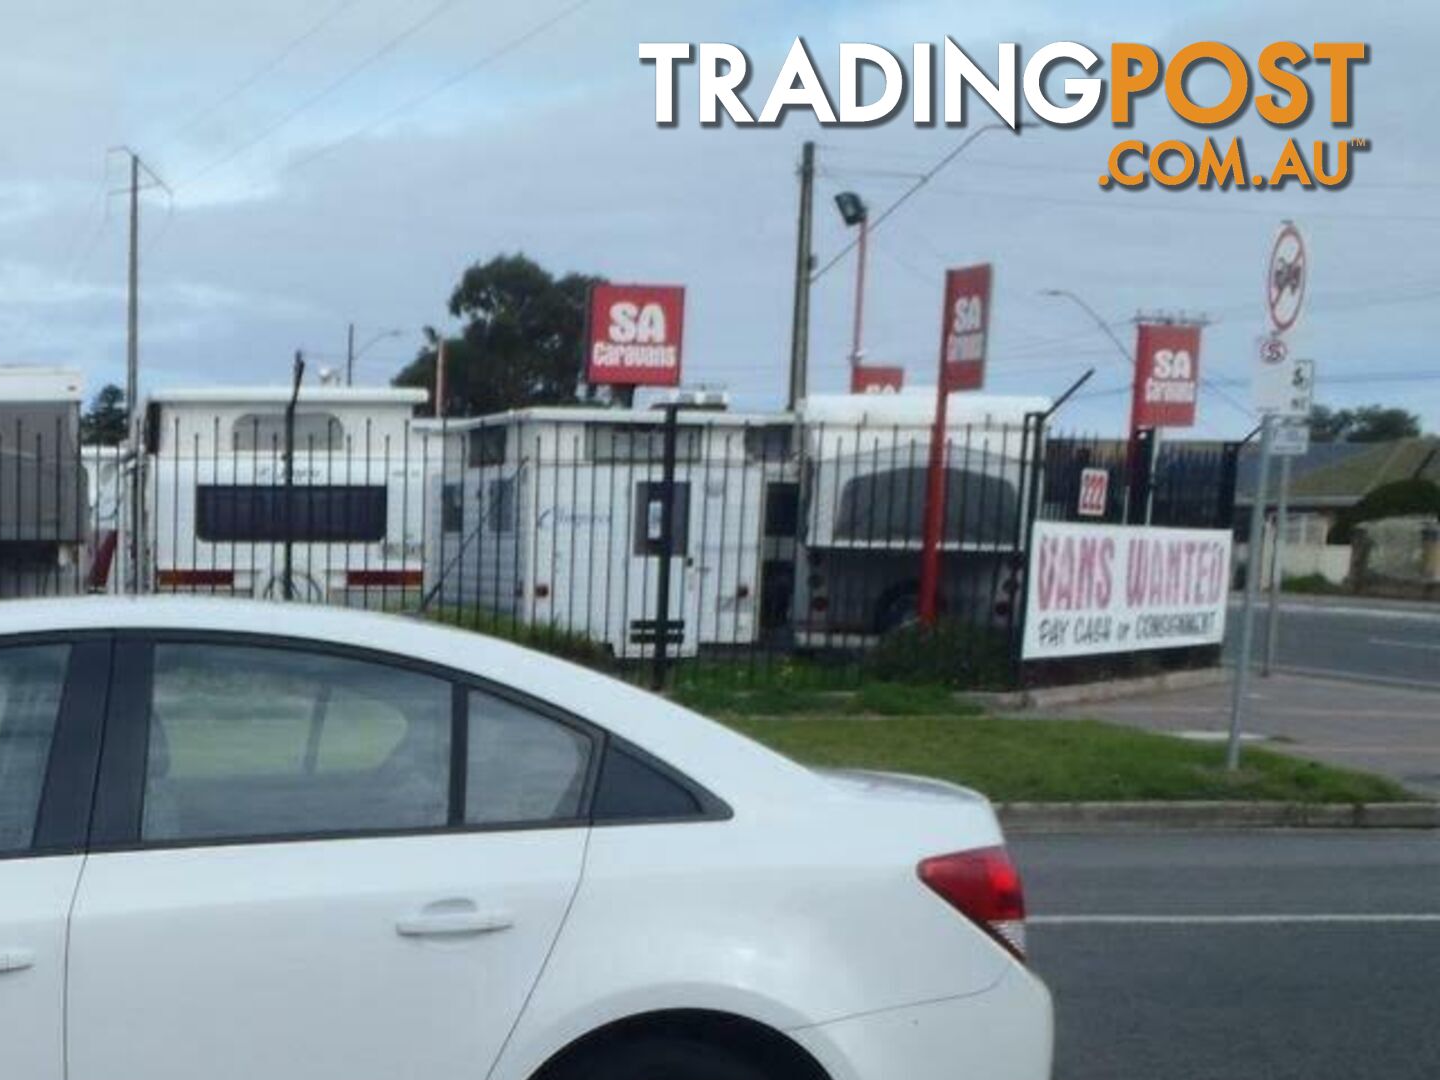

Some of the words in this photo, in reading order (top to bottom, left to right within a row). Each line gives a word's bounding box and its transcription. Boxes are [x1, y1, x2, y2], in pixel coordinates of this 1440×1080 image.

[609, 302, 665, 343] SA
[954, 296, 981, 333] SA
[592, 340, 676, 368] Caravans
[1153, 349, 1192, 379] SA
[1037, 535, 1115, 612] VANS
[1126, 537, 1225, 609] WANTED
[1037, 616, 1070, 648] PAY
